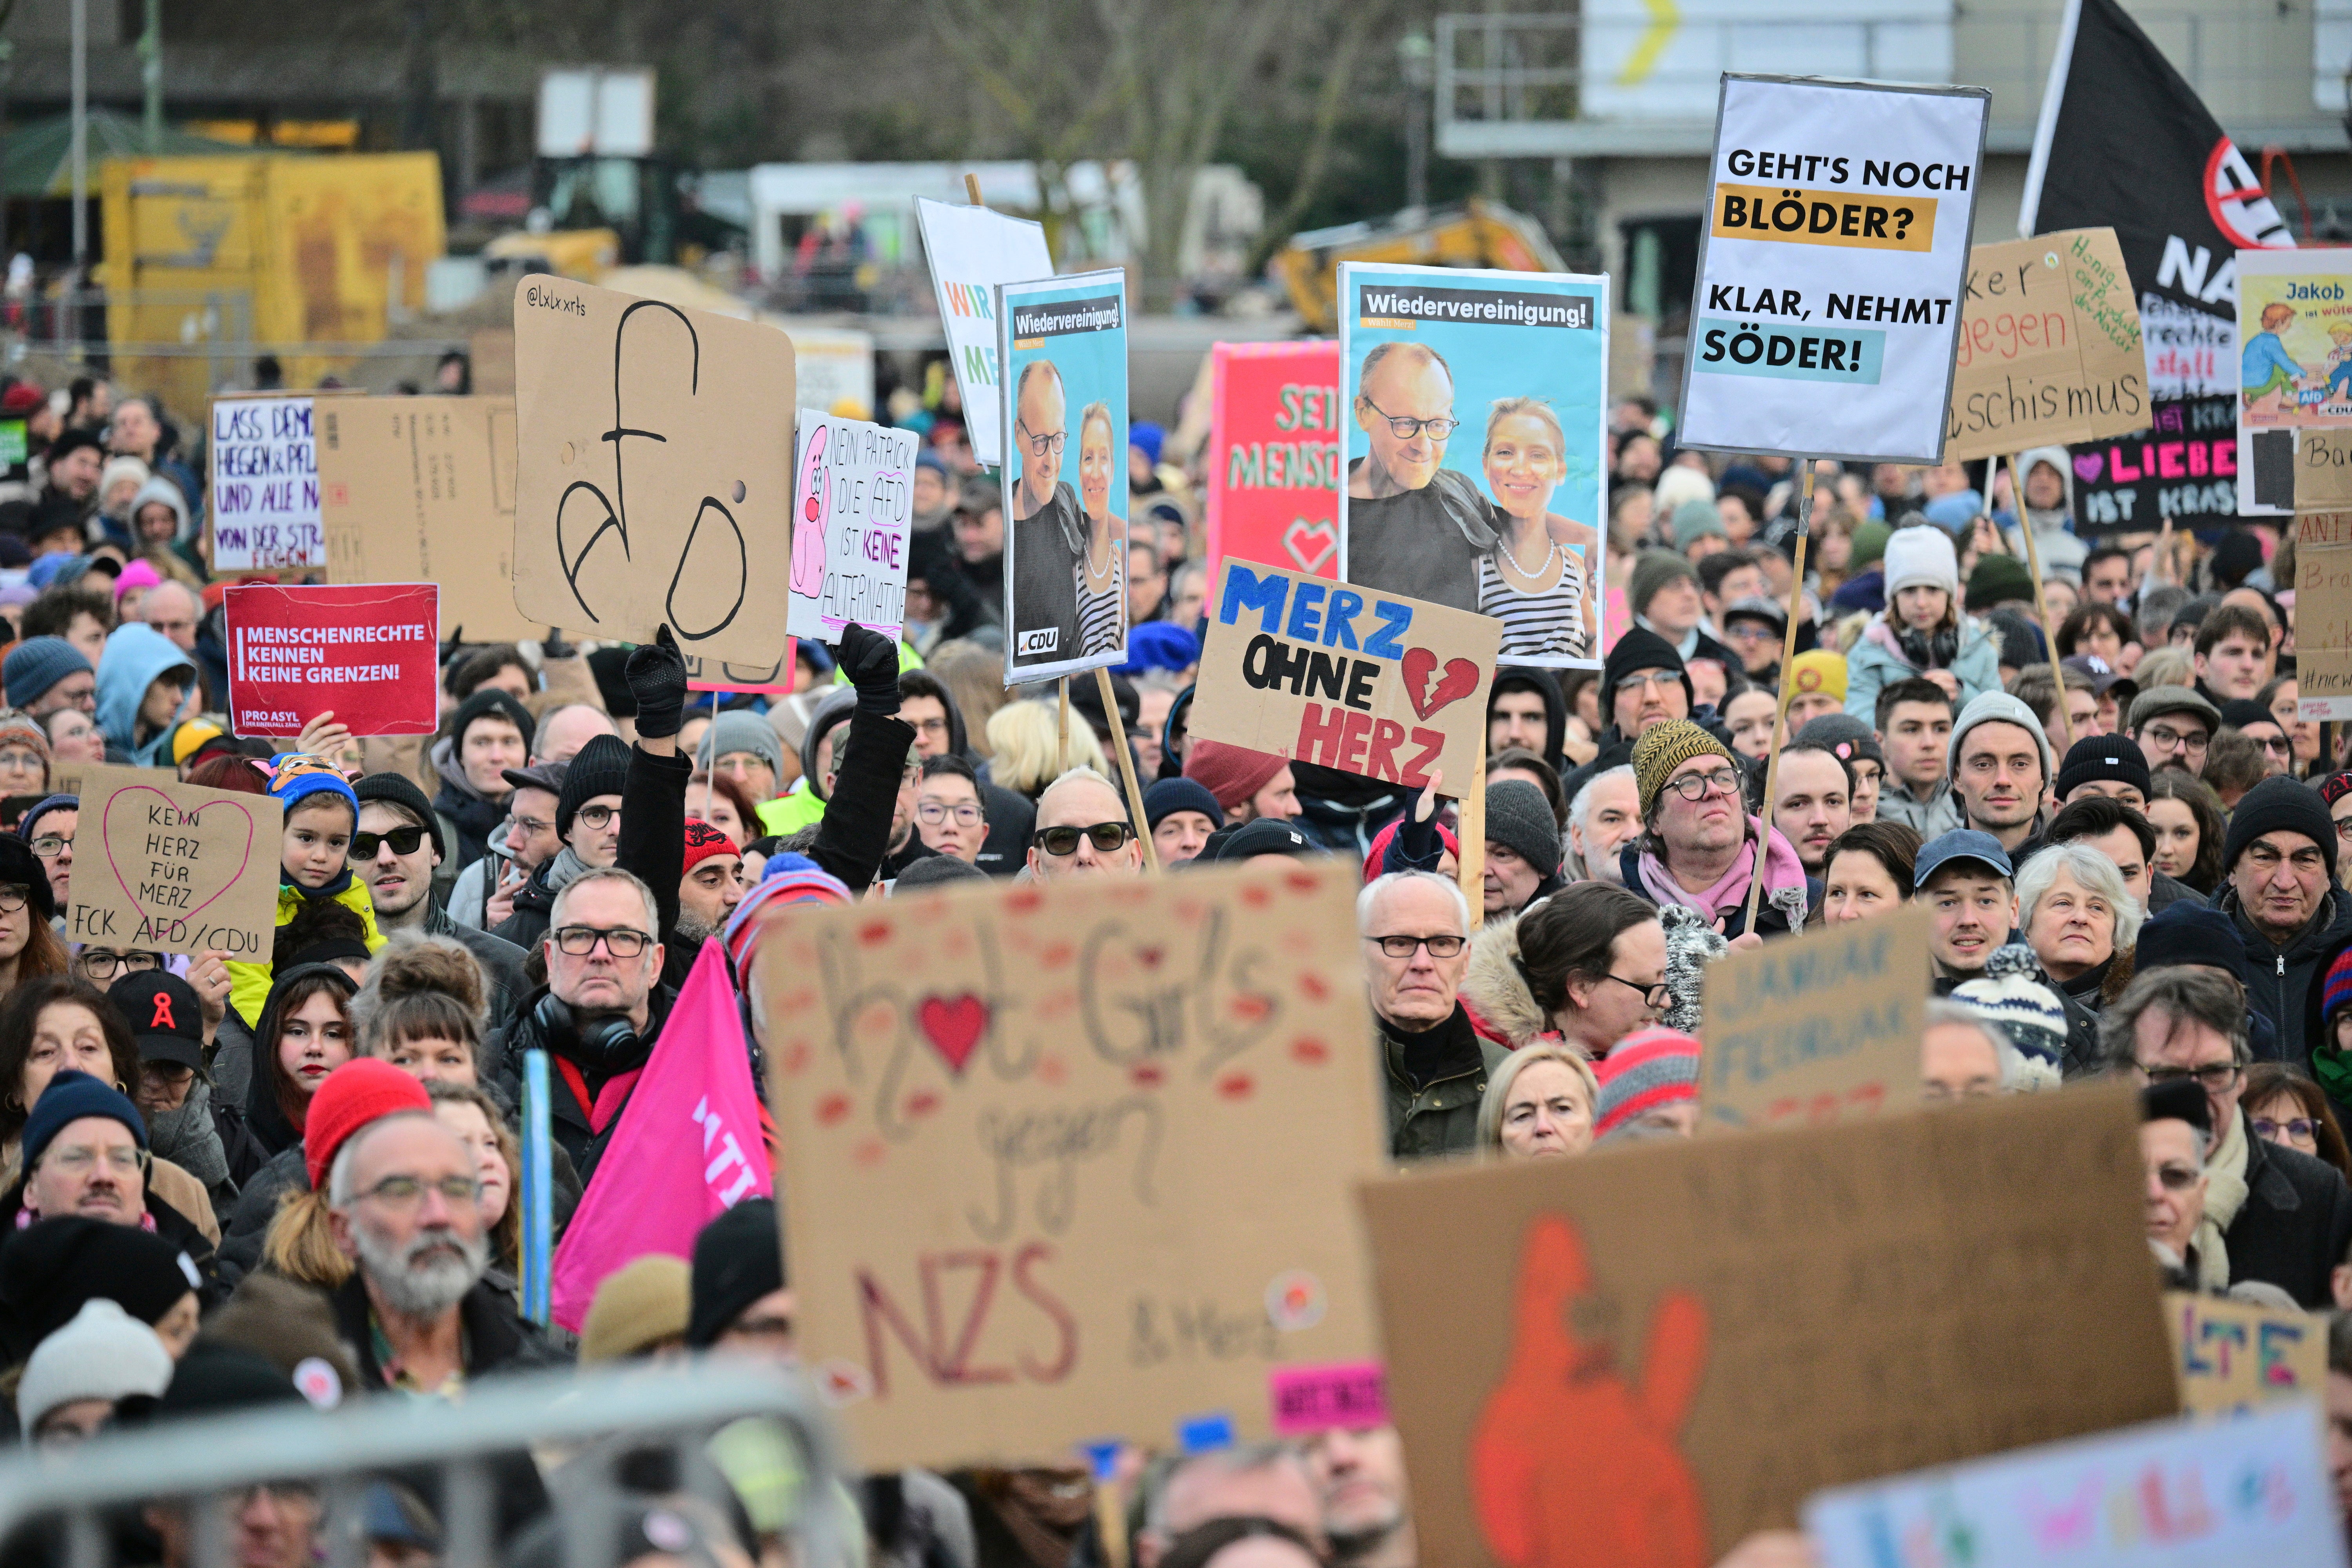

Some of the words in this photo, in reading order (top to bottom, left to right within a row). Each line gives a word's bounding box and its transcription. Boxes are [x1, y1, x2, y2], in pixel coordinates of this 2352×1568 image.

[1728, 149, 1849, 184] GEHT'S
[1862, 160, 1971, 191] NOCH
[1722, 189, 1915, 240] BLÖDER?
[945, 280, 995, 320] WIR
[1708, 285, 1811, 321] KLAR,
[1826, 293, 1952, 325] NEHMT
[2286, 281, 2345, 300] Jakob
[1016, 302, 1120, 335] Wiedervereinigung!
[1367, 293, 1586, 328] Wiedervereinigung!
[1368, 318, 1392, 327] Wählt
[1393, 319, 1414, 328] Merz!
[1018, 339, 1032, 348] Wählt
[1033, 338, 1044, 347] Merz!
[1702, 322, 1862, 372] SÖDER!
[216, 407, 262, 442] LASS
[216, 445, 269, 477] HEGEN
[829, 427, 859, 466] NEIN
[865, 430, 911, 470] PATRICK
[2109, 438, 2237, 484] LIEBE
[217, 484, 252, 515] UND
[261, 481, 293, 513] ALLE
[838, 477, 864, 514] DIE
[871, 477, 906, 521] AFD
[2085, 488, 2137, 524] IST
[216, 527, 247, 550] VON
[252, 524, 281, 551] DER
[840, 527, 859, 556] IST
[862, 529, 902, 570] KEINE
[822, 572, 906, 624] ALTERNATIVE
[1220, 564, 1413, 661] MERZ
[247, 624, 424, 644] MENSCHENRECHTE
[1028, 631, 1056, 651] CDU
[248, 646, 323, 664] KENNEN
[1242, 633, 1381, 711] OHNE
[249, 666, 302, 683] KEINE
[306, 664, 399, 683] GRENZEN!
[245, 710, 269, 721] PRO
[270, 711, 300, 722] ASYL
[1296, 702, 1445, 788] HERZ
[149, 805, 200, 827] KEIN
[145, 833, 200, 860] HERZ
[151, 861, 189, 883] FÜR
[140, 881, 192, 909] MERZ
[75, 905, 116, 936] FCK
[854, 1240, 1080, 1399] NZS
